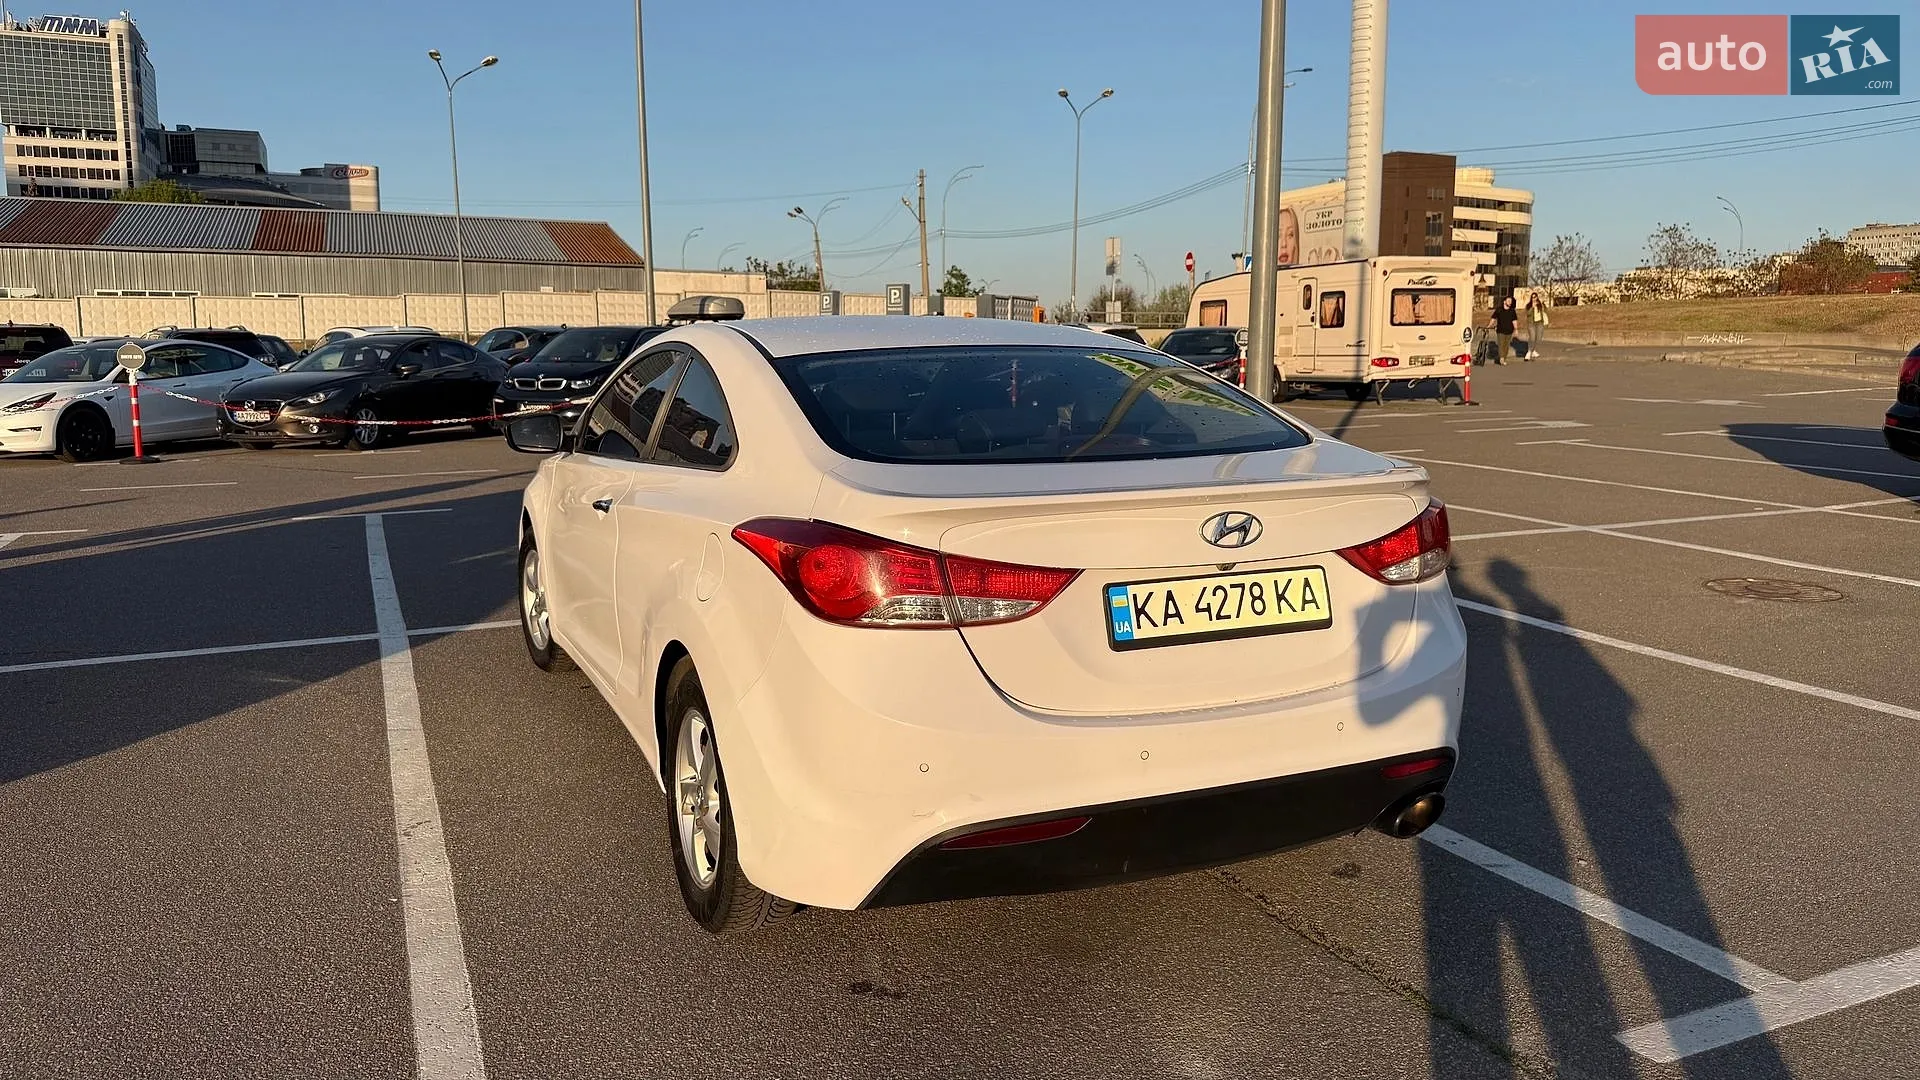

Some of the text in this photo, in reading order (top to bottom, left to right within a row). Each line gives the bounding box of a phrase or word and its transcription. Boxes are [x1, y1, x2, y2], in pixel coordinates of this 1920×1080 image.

[1316, 210, 1333, 220] УКР
[1306, 218, 1343, 230] ЗОЛОТО
[1133, 577, 1320, 629] KA 4278 KA
[1115, 622, 1131, 634] UA
